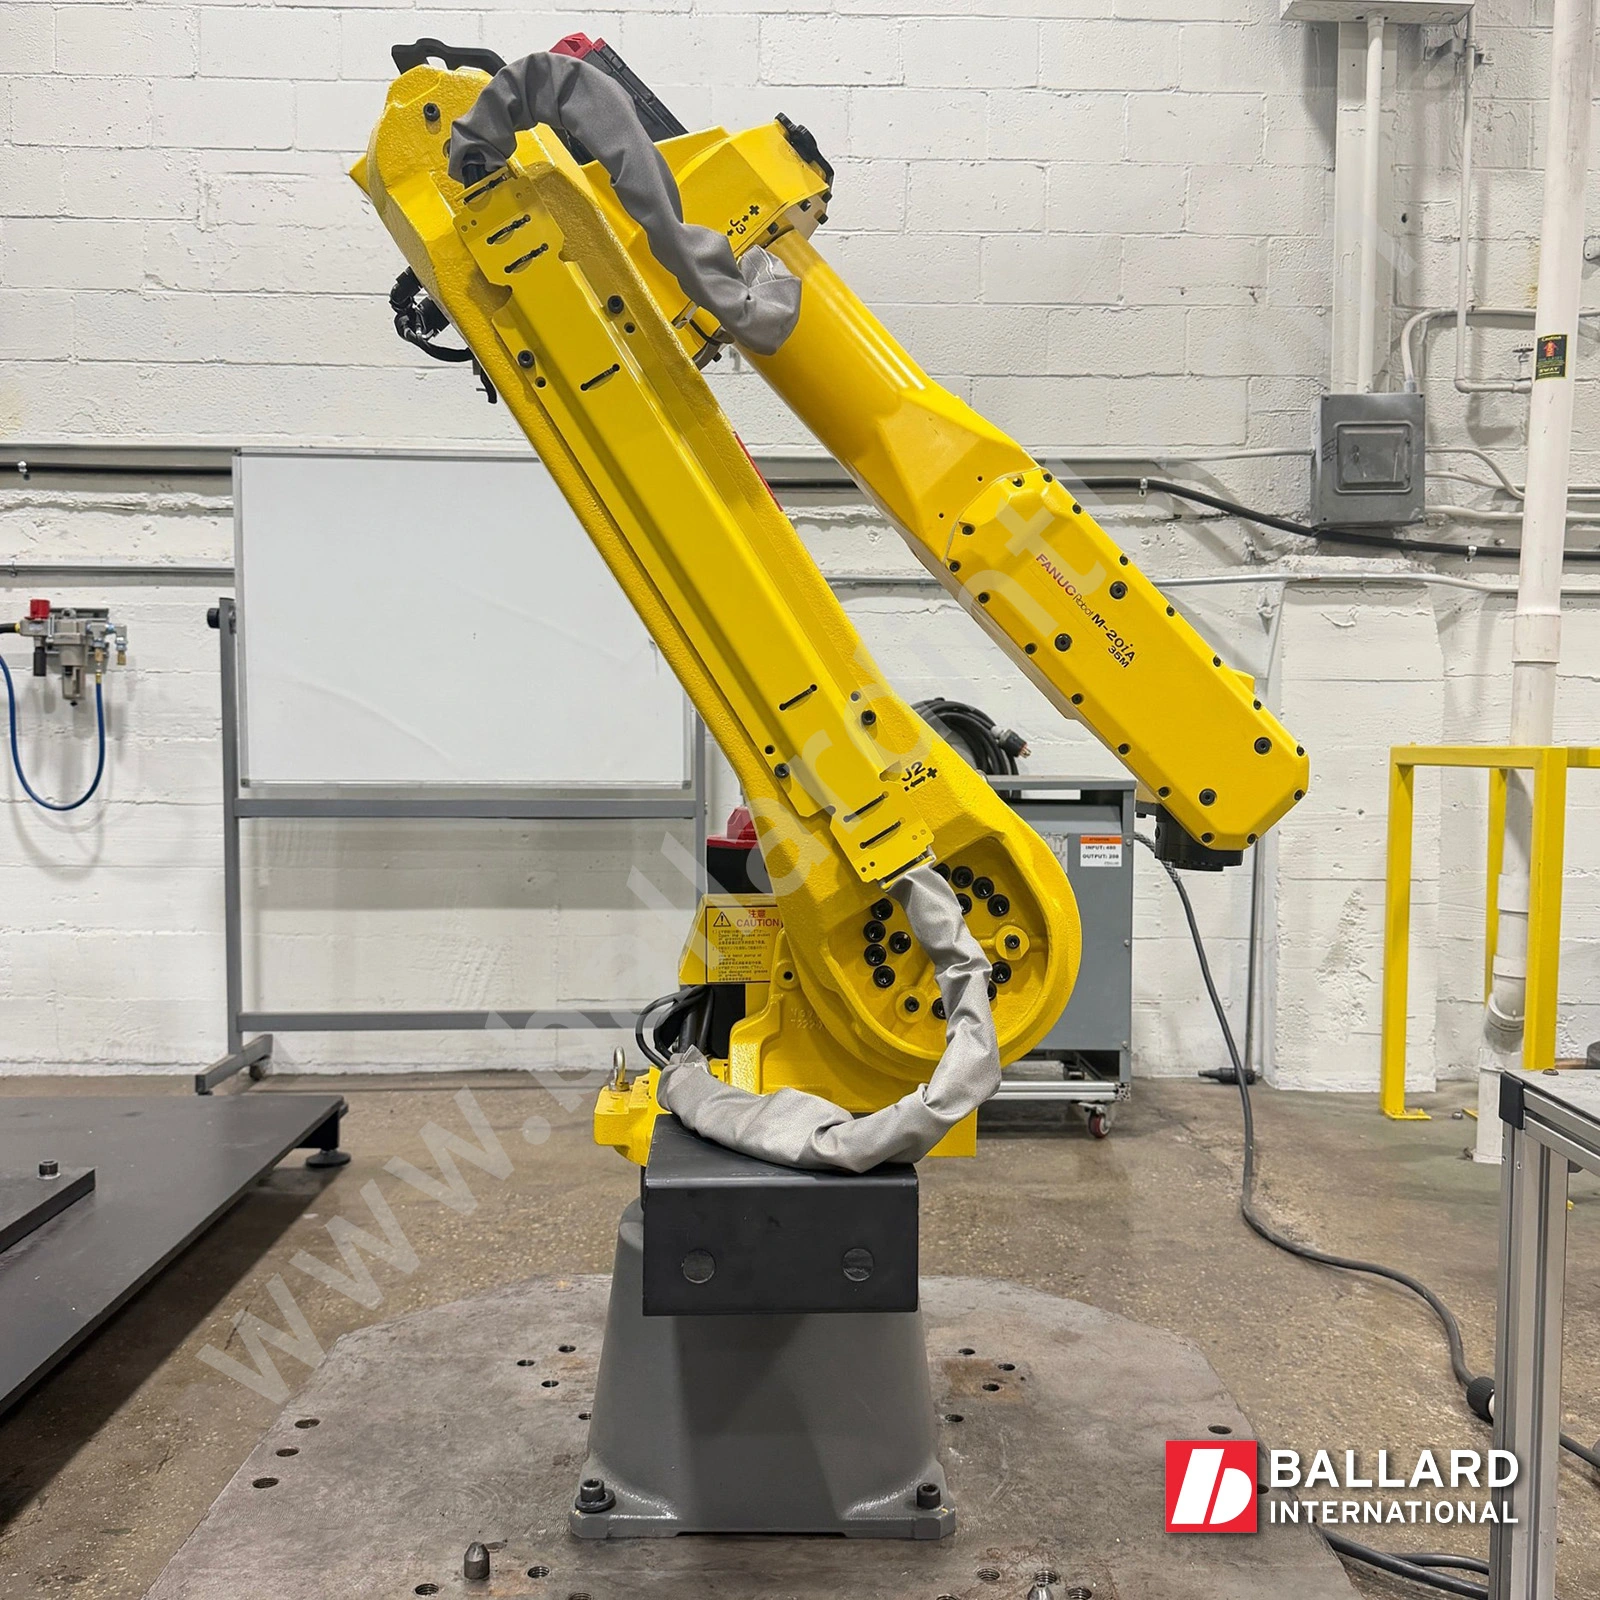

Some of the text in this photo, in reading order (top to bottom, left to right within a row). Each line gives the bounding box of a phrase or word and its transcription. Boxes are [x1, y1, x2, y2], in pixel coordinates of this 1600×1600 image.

[729, 219, 747, 234] J3
[1035, 553, 1136, 662] FANUC Robot M-20iA
[1107, 645, 1130, 668] 35M
[901, 761, 926, 782] J2
[748, 909, 766, 919] 注意
[736, 919, 780, 928] CAUTION
